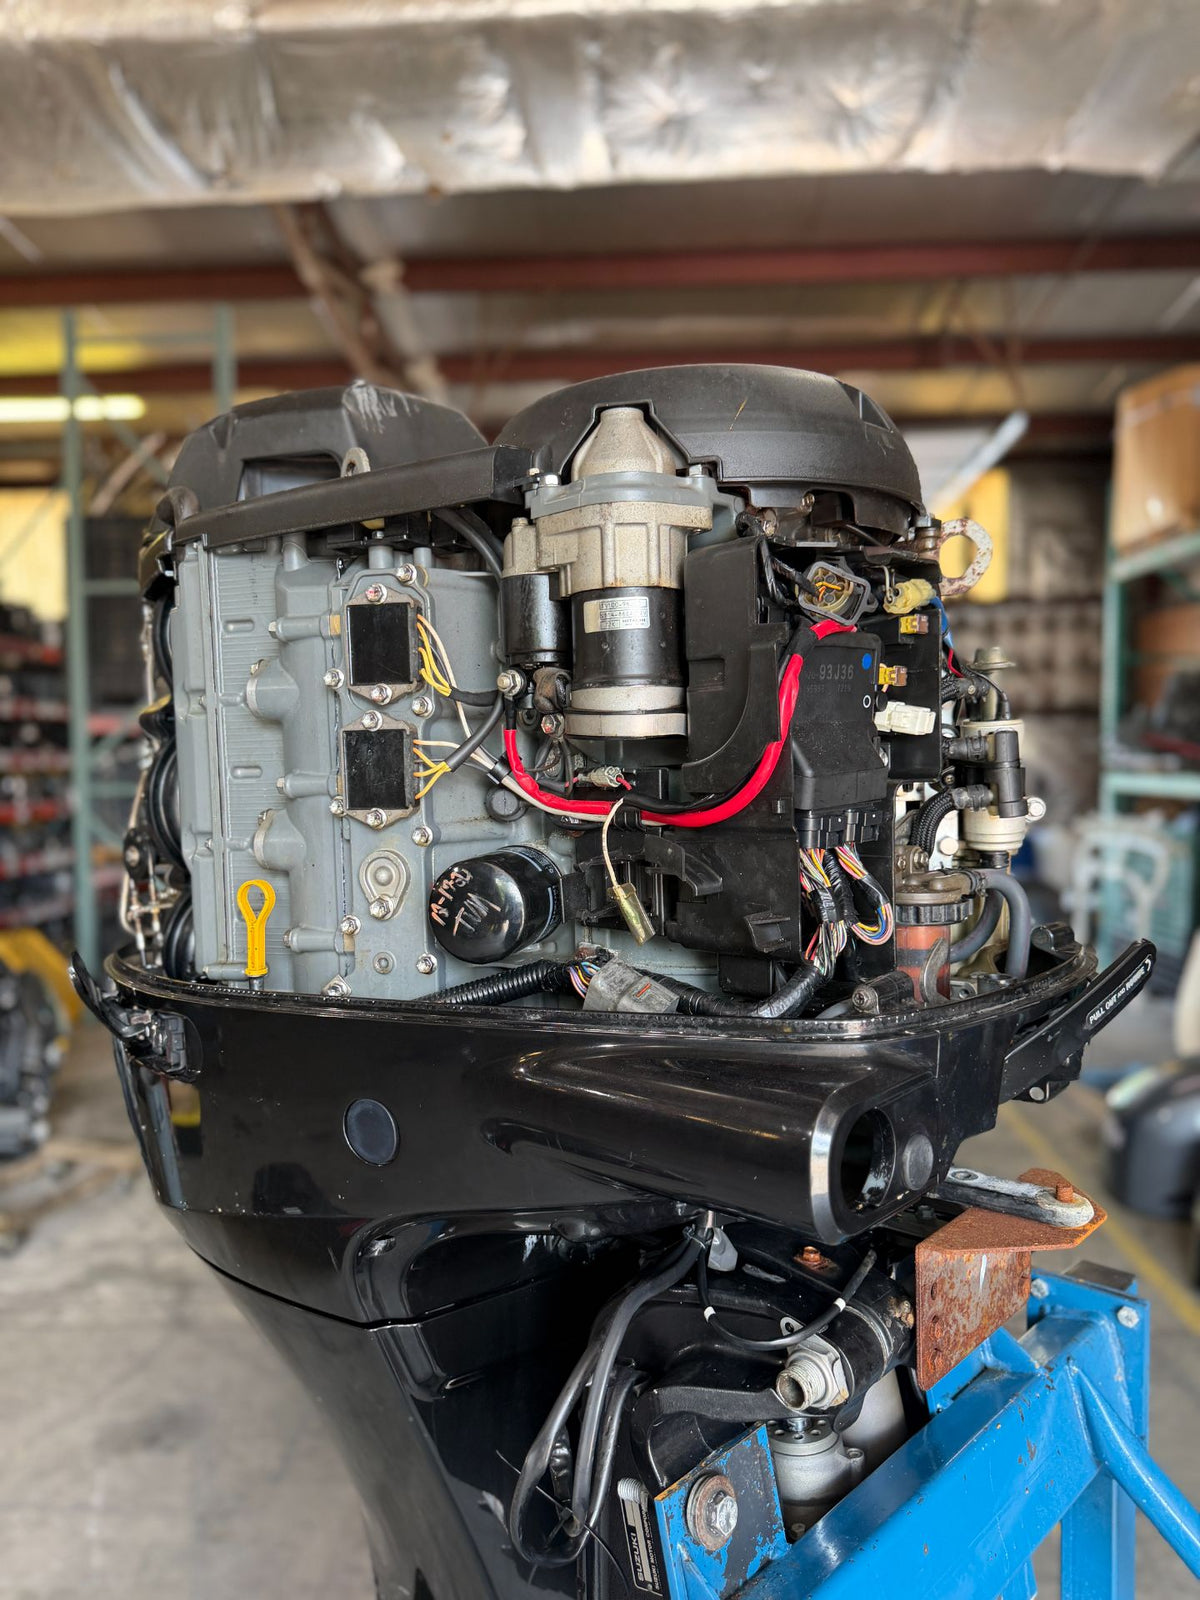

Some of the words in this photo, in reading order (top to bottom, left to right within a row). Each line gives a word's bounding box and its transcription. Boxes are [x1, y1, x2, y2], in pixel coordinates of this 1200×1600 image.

[1089, 1007, 1105, 1024] PULL
[630, 1532, 645, 1582] SUZUKI
[651, 1565, 660, 1590] SUZUKI
